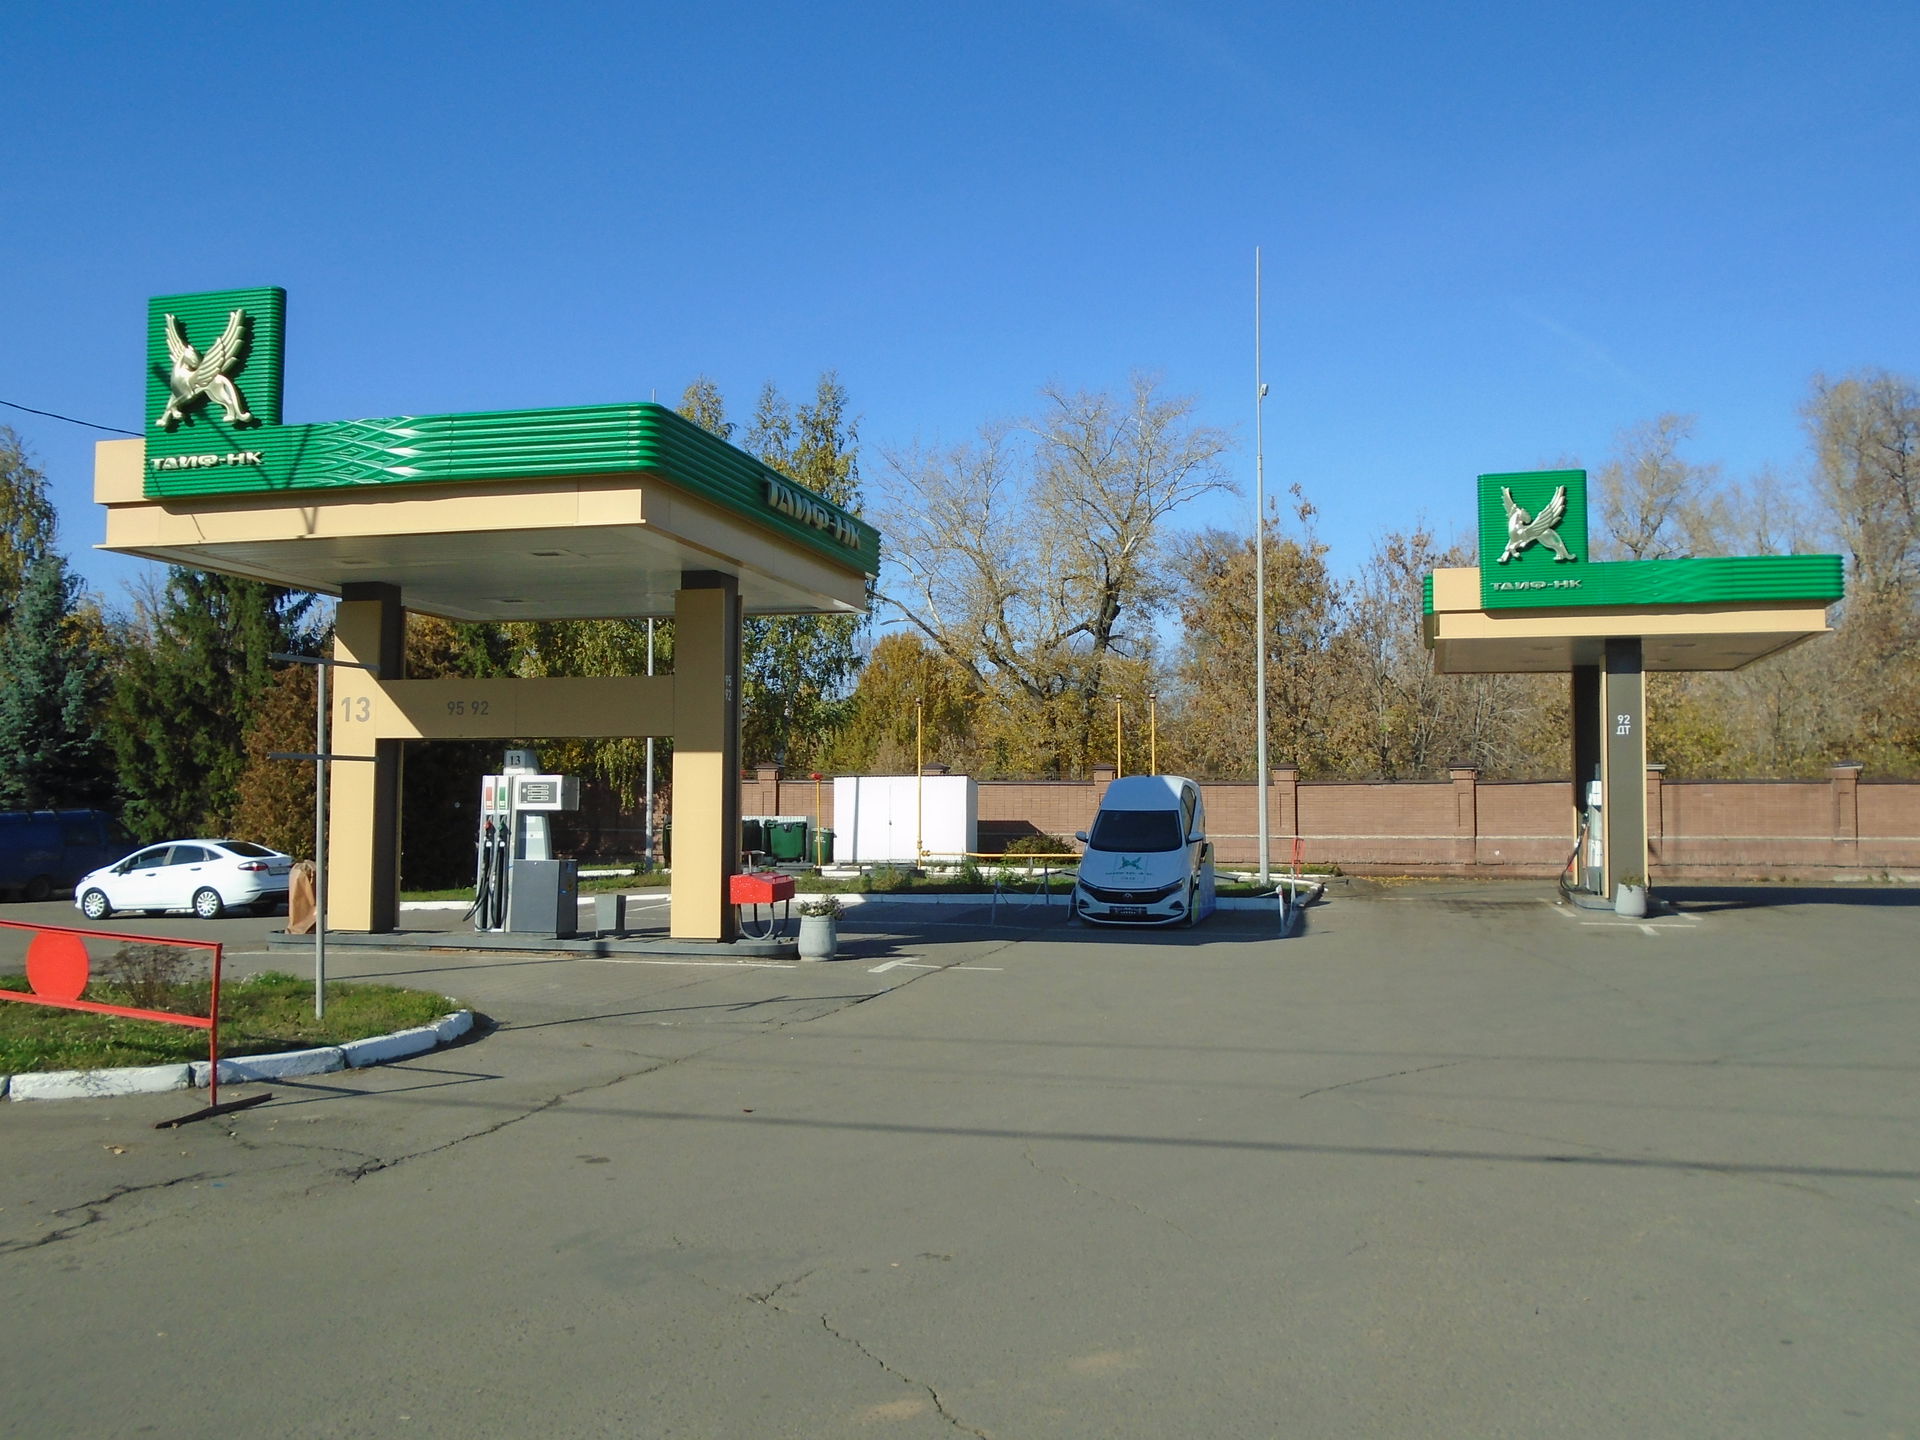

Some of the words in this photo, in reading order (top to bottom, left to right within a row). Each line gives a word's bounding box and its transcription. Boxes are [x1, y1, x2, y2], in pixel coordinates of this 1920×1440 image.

[151, 451, 262, 470] ТАИФ-НК
[764, 475, 861, 550] ТАИФ-НК
[1490, 580, 1582, 590] ТАИФ-НК
[341, 697, 370, 722] 13
[447, 701, 464, 716] 95
[471, 701, 489, 716] 92
[1617, 714, 1631, 725] 92
[1616, 725, 1631, 735] ДТ
[510, 755, 521, 766] 13
